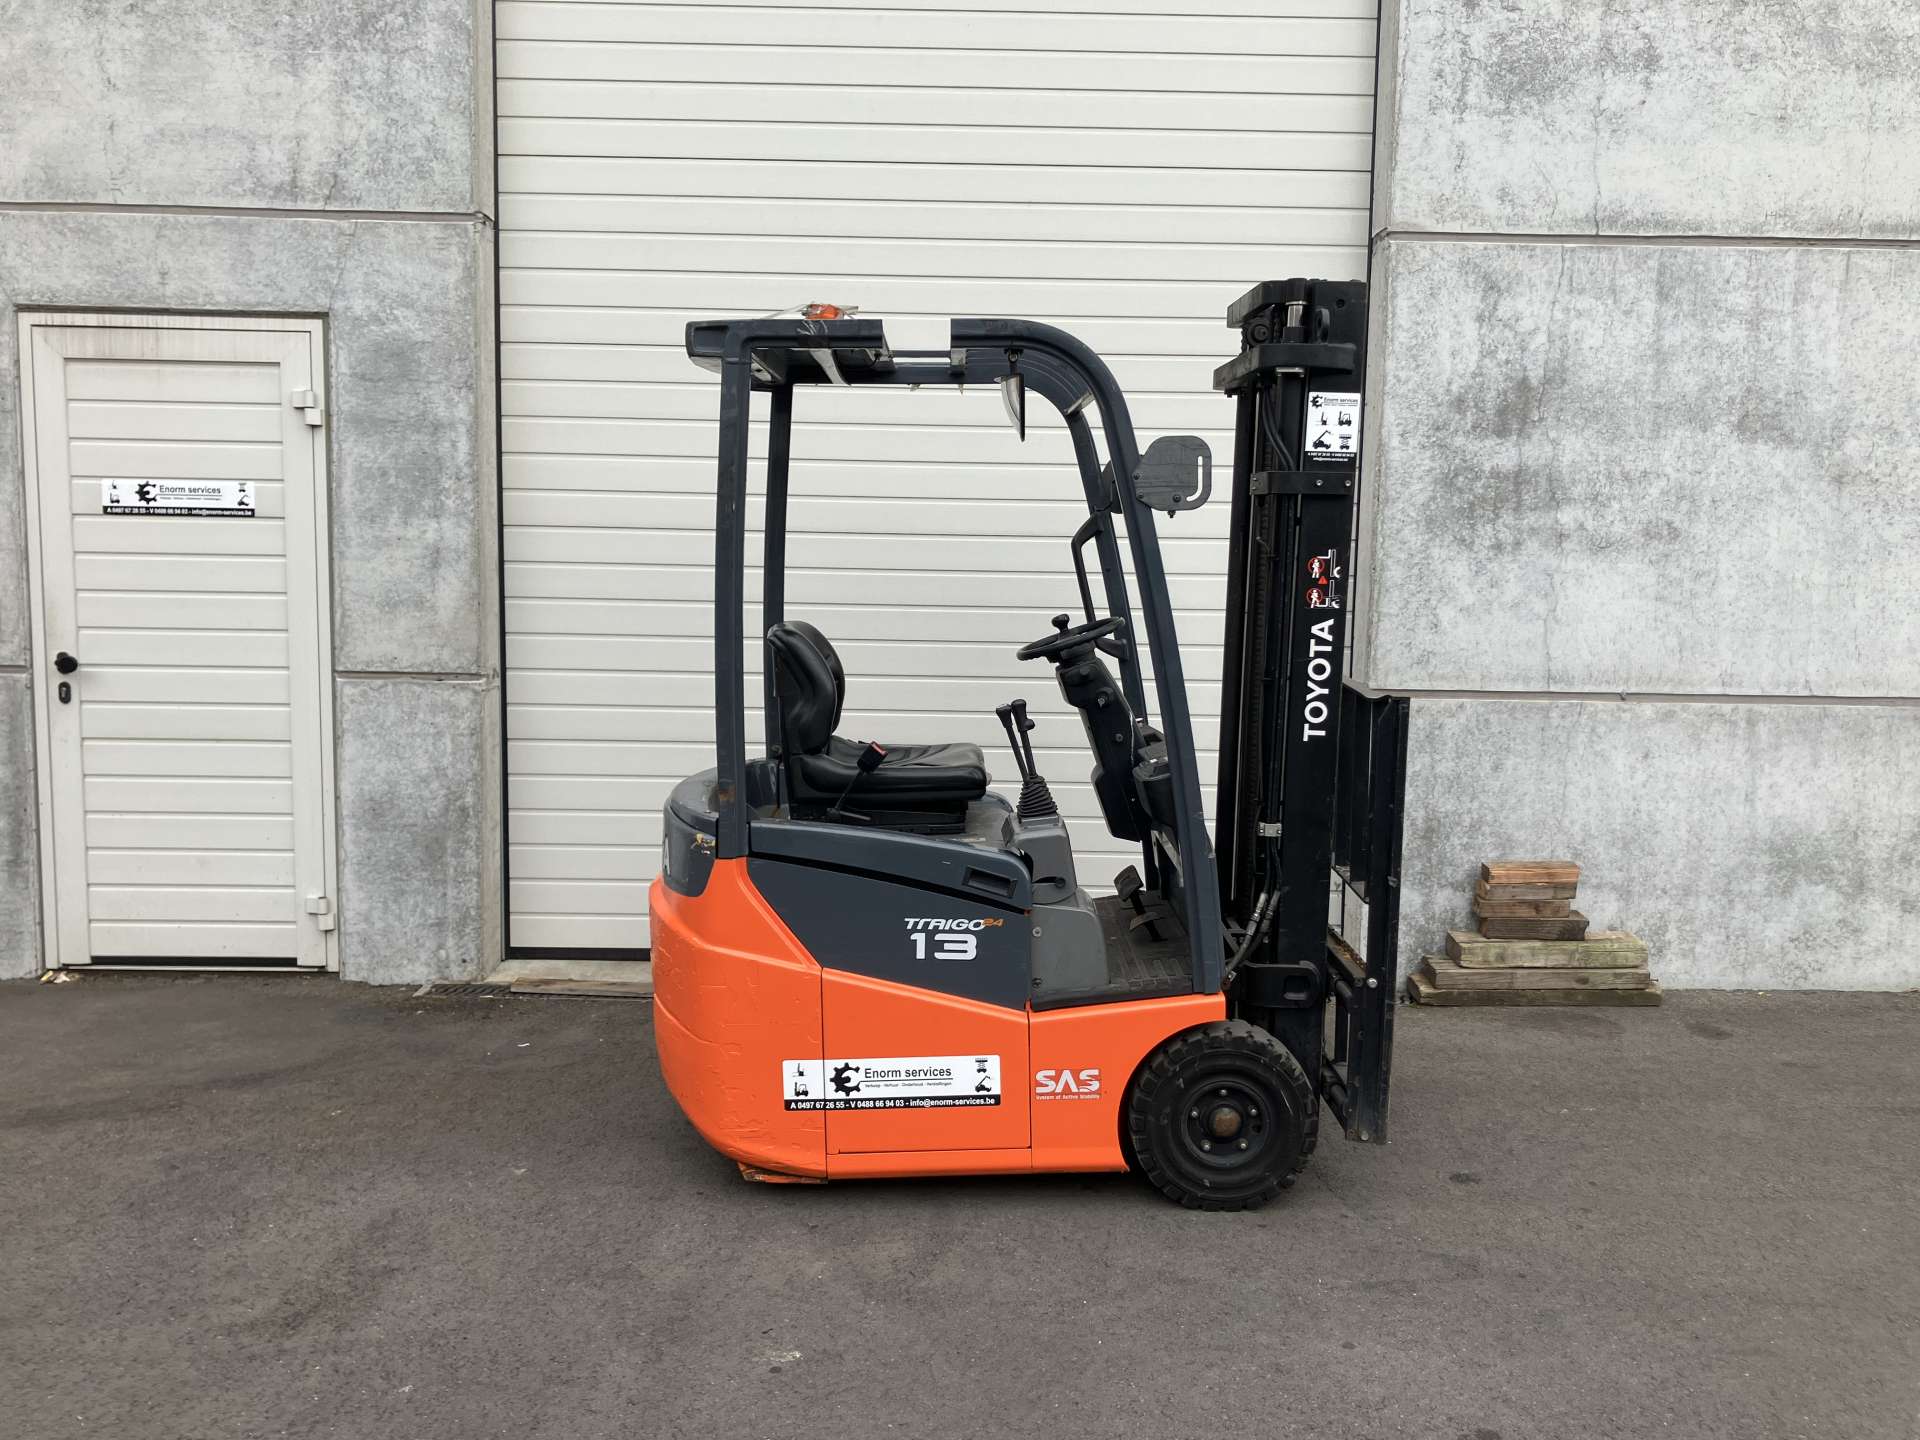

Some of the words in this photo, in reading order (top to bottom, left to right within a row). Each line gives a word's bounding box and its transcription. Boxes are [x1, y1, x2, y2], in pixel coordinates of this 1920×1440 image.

[159, 484, 186, 493] Enorm
[188, 485, 221, 494] services
[1303, 618, 1335, 741] TOYOTA
[910, 932, 977, 960] 13
[864, 1068, 901, 1079] Enorm
[904, 1066, 952, 1078] services
[1035, 1069, 1100, 1093] SAS
[797, 1101, 815, 1109] 0497
[815, 1101, 825, 1109] 67
[825, 1101, 835, 1109] 26
[857, 1100, 874, 1108] 0488
[885, 1099, 894, 1107] 94
[910, 1098, 995, 1107] info@enorm-services.be
